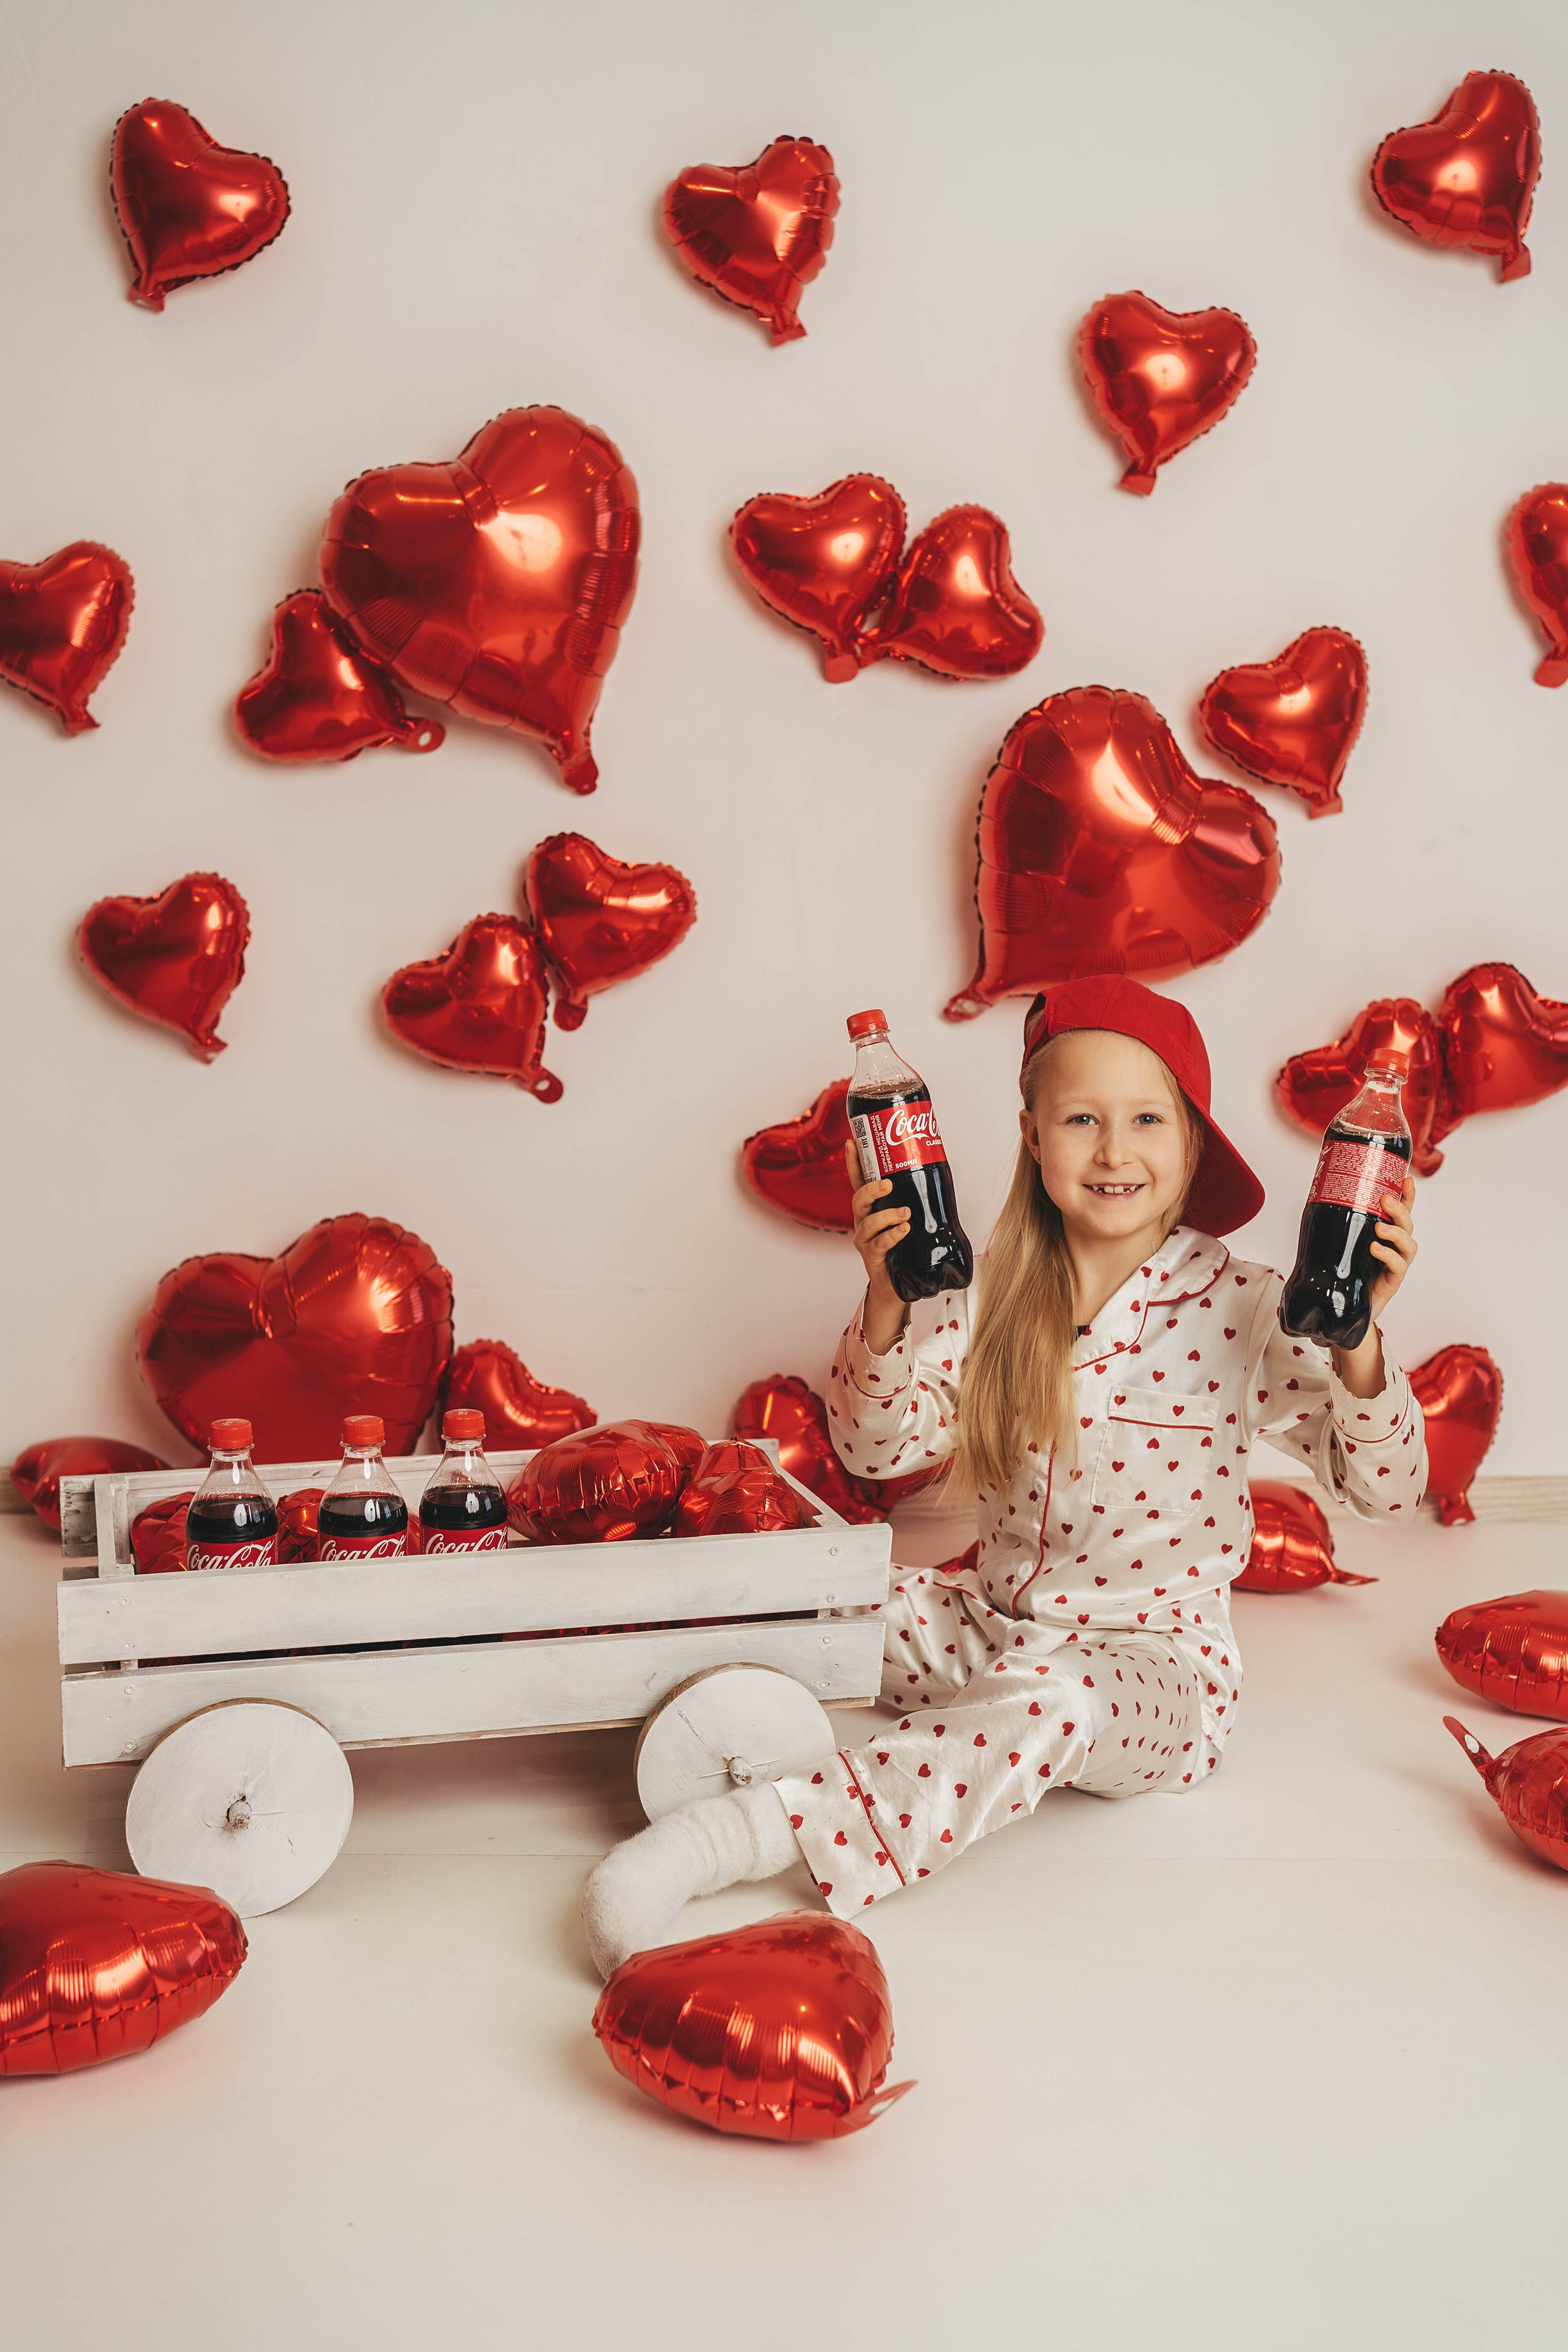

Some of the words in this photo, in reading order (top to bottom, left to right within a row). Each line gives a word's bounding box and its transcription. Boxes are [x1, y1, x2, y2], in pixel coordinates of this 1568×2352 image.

[870, 1115, 881, 1145] МЕШАВАД
[885, 1105, 940, 1146] Coca-C
[878, 1145, 889, 1173] КОРКАРД
[879, 1131, 894, 1171] ПЕРЕРАБОТАЙ
[895, 1158, 918, 1169] 500МЛ
[320, 1534, 407, 1561] Coca-Cl
[426, 1526, 507, 1555] Coca-Cl
